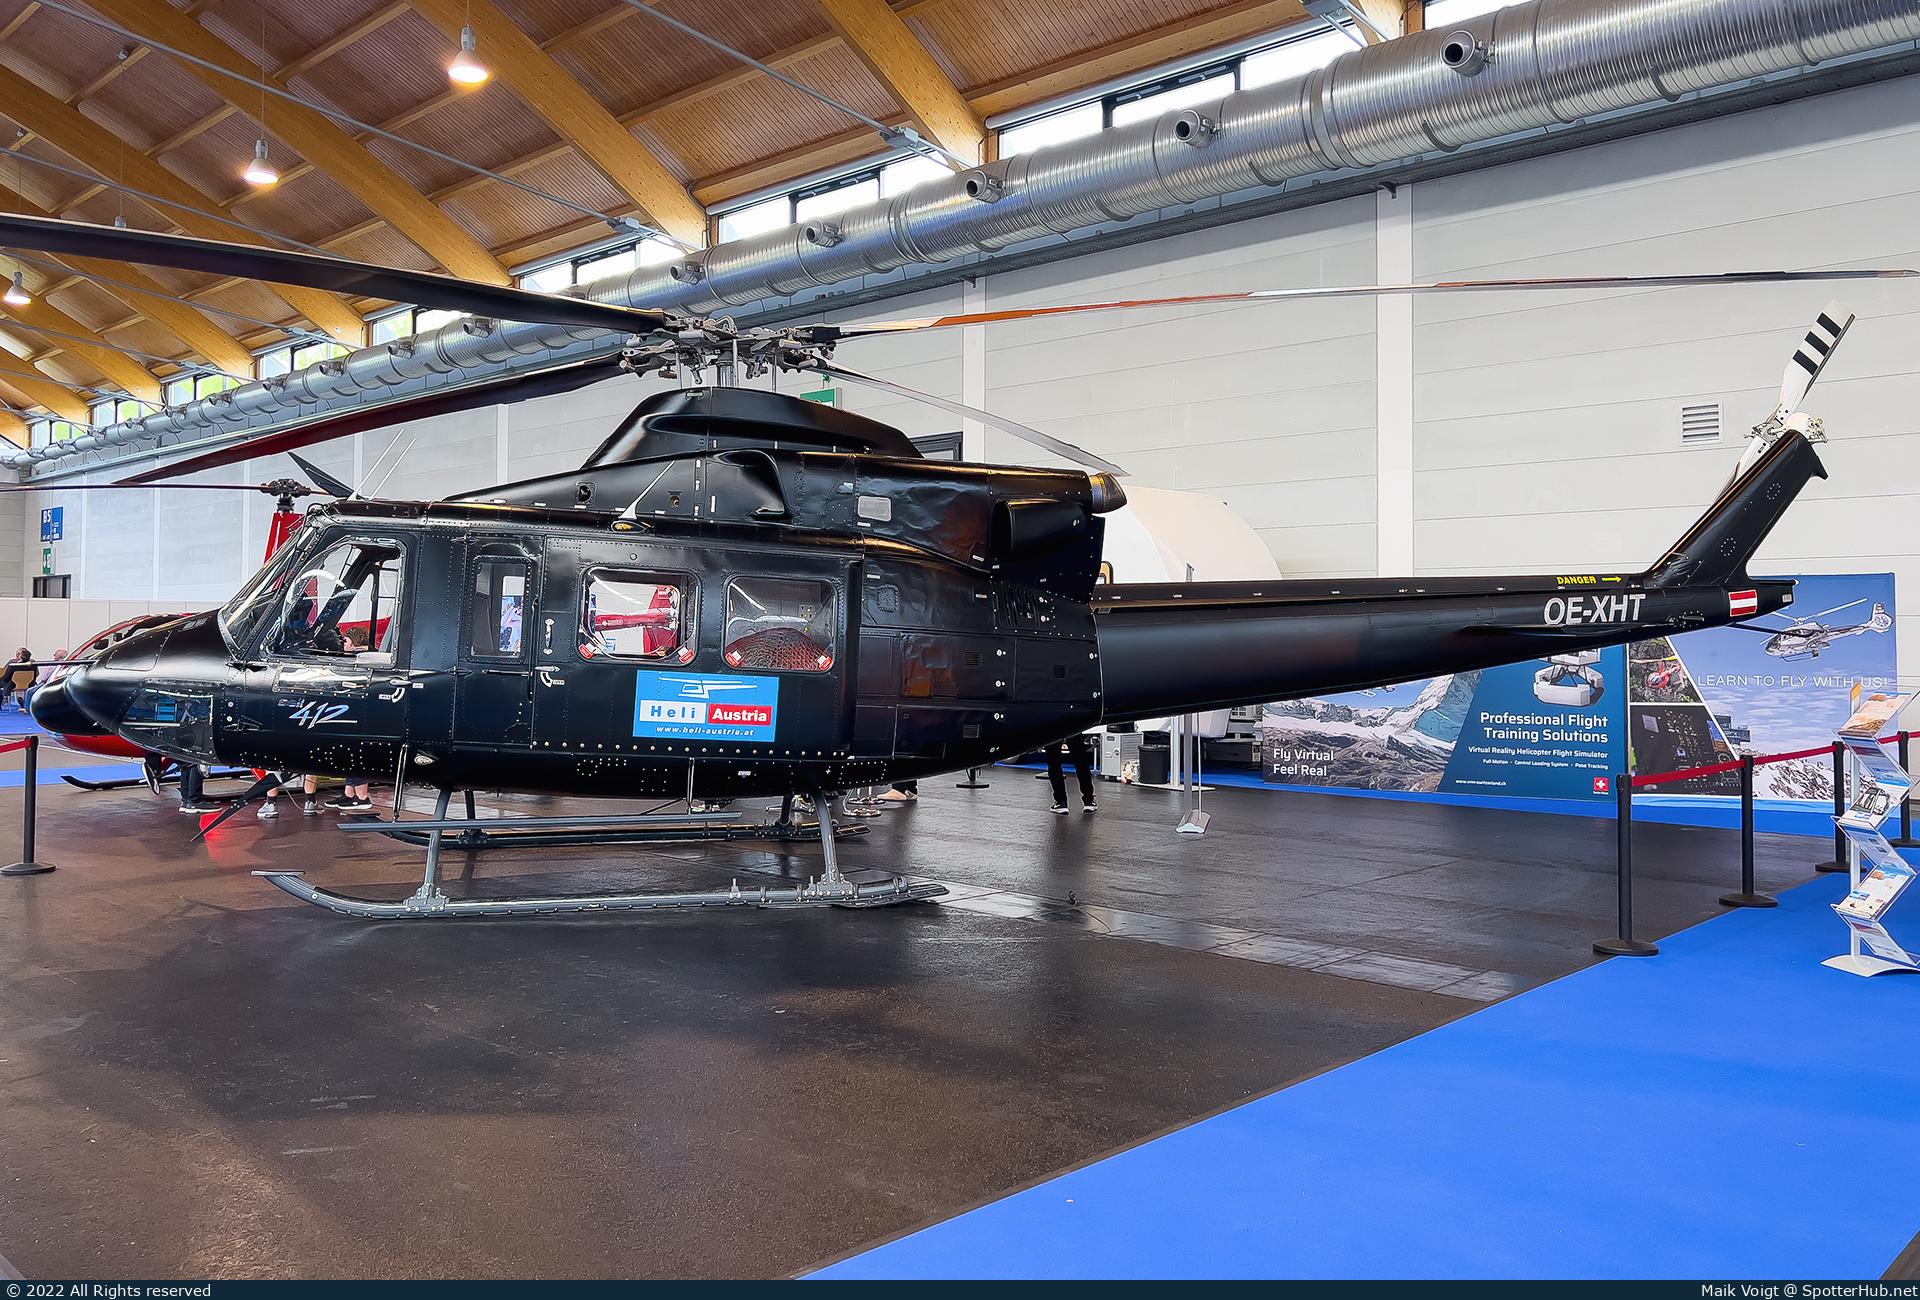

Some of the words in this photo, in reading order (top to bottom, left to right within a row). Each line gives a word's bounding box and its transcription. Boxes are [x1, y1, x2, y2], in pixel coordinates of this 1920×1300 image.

[43, 510, 51, 523] B5
[1556, 576, 1597, 584] DANGER
[1544, 594, 1646, 625] OE-XHT
[1697, 675, 1748, 686] LEARN
[1754, 675, 1775, 686] TO
[1781, 675, 1807, 687] FLY
[1813, 676, 1854, 687] WITH
[1861, 676, 1888, 687] US!
[289, 701, 358, 729] 412
[650, 705, 696, 719] Heli
[711, 707, 767, 722] Austria
[1480, 711, 1564, 726] Professional
[1568, 714, 1608, 729] Flight
[656, 725, 754, 736] www.heli-austria.at
[1483, 727, 1539, 742] Training
[1542, 729, 1608, 743] Solutions
[1273, 748, 1291, 761] Fly
[1294, 748, 1334, 761] Virtual
[1492, 747, 1515, 755] Reality
[1516, 748, 1551, 757] Helicopter
[1552, 749, 1572, 758] Flight
[1573, 750, 1608, 759] Simulator
[1273, 763, 1298, 775] Feel
[1301, 764, 1327, 776] Real
